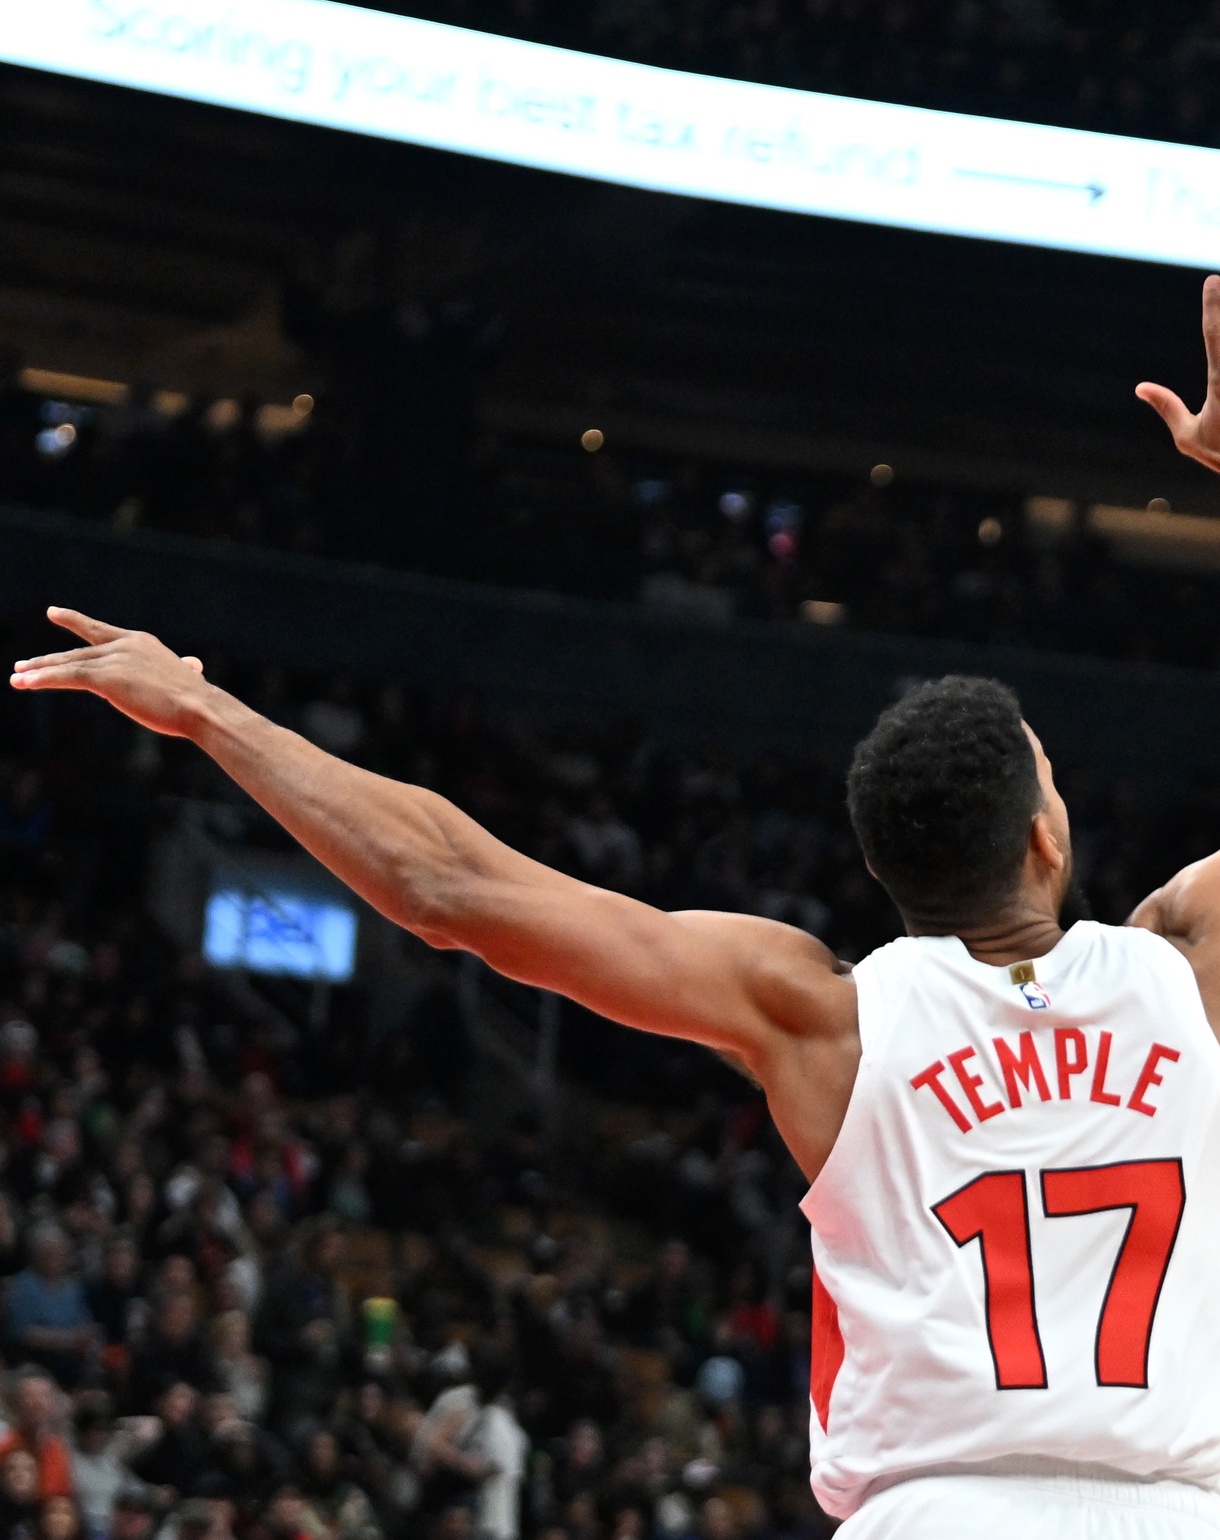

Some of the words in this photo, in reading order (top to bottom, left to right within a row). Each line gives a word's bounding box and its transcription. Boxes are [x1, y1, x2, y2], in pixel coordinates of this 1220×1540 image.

[329, 49, 459, 103] your
[475, 60, 600, 135] best
[719, 110, 922, 188] refund
[909, 1027, 1182, 1134] TEMPLE
[930, 1156, 1186, 1390] 17
